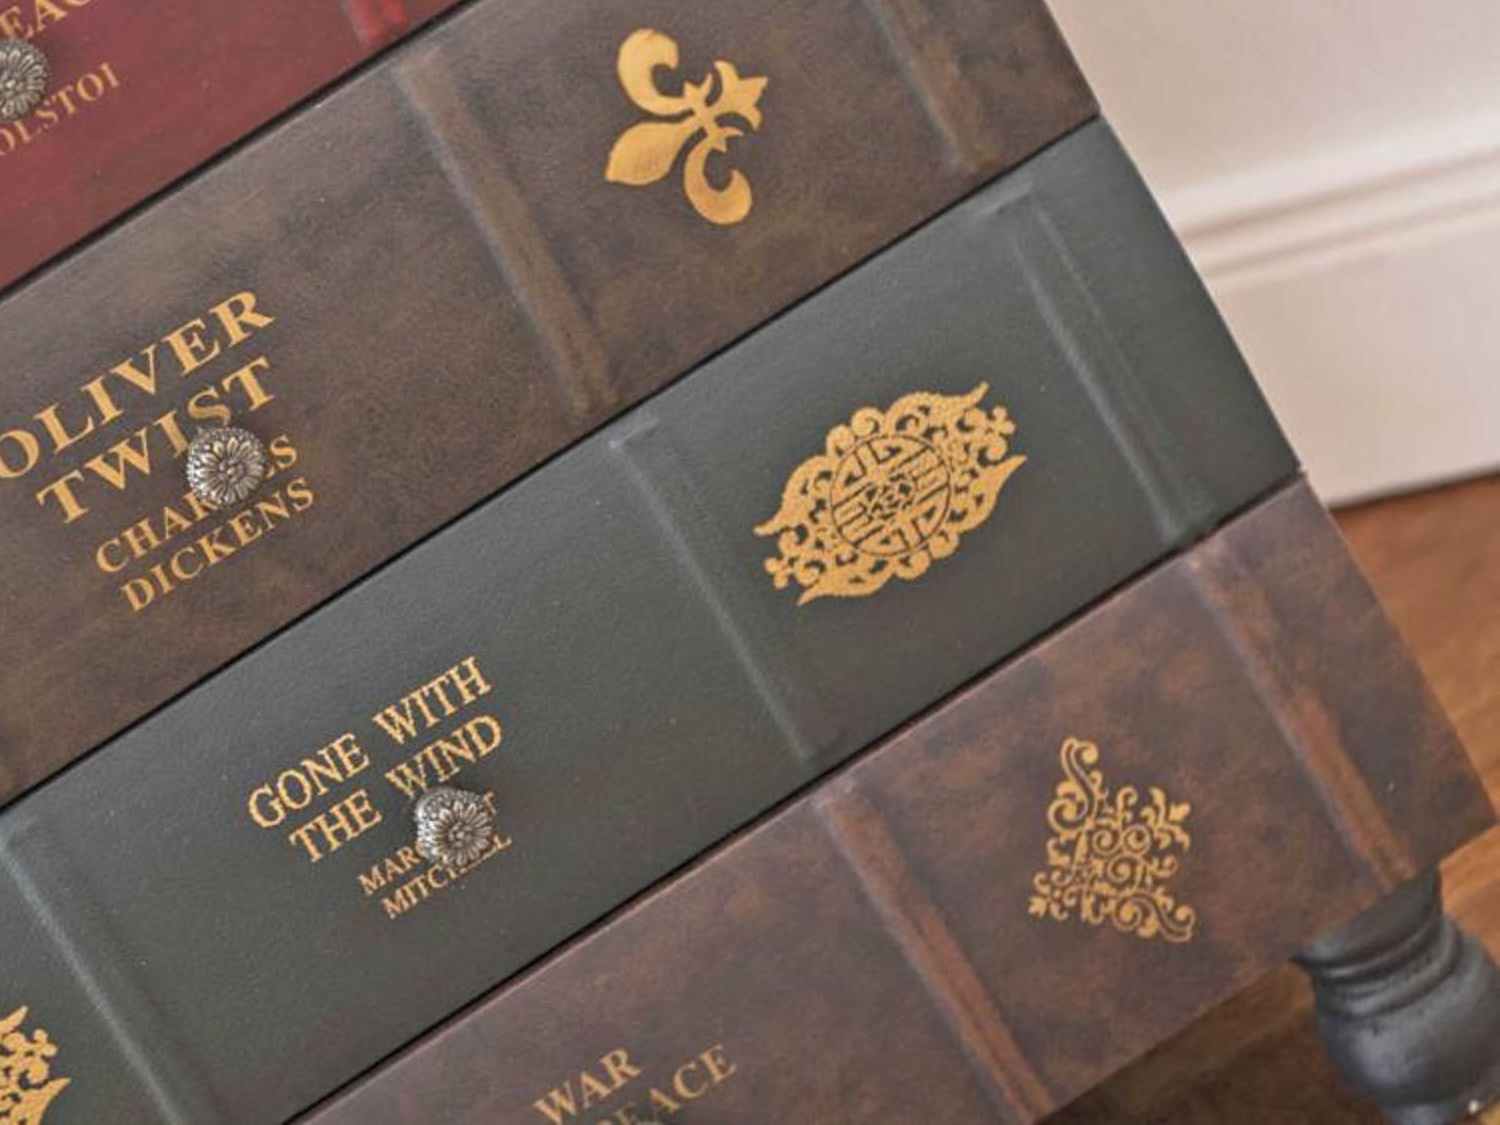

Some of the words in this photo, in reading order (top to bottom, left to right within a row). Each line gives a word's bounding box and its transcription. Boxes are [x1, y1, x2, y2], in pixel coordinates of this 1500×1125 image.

[36, 356, 276, 524] TWIST
[96, 434, 297, 574] CHARS
[121, 476, 315, 612] DICKENS
[248, 732, 370, 828] GONE
[371, 656, 491, 744] WITH
[288, 789, 383, 862] THE
[385, 715, 501, 800] WIND
[532, 1048, 642, 1125] WAR
